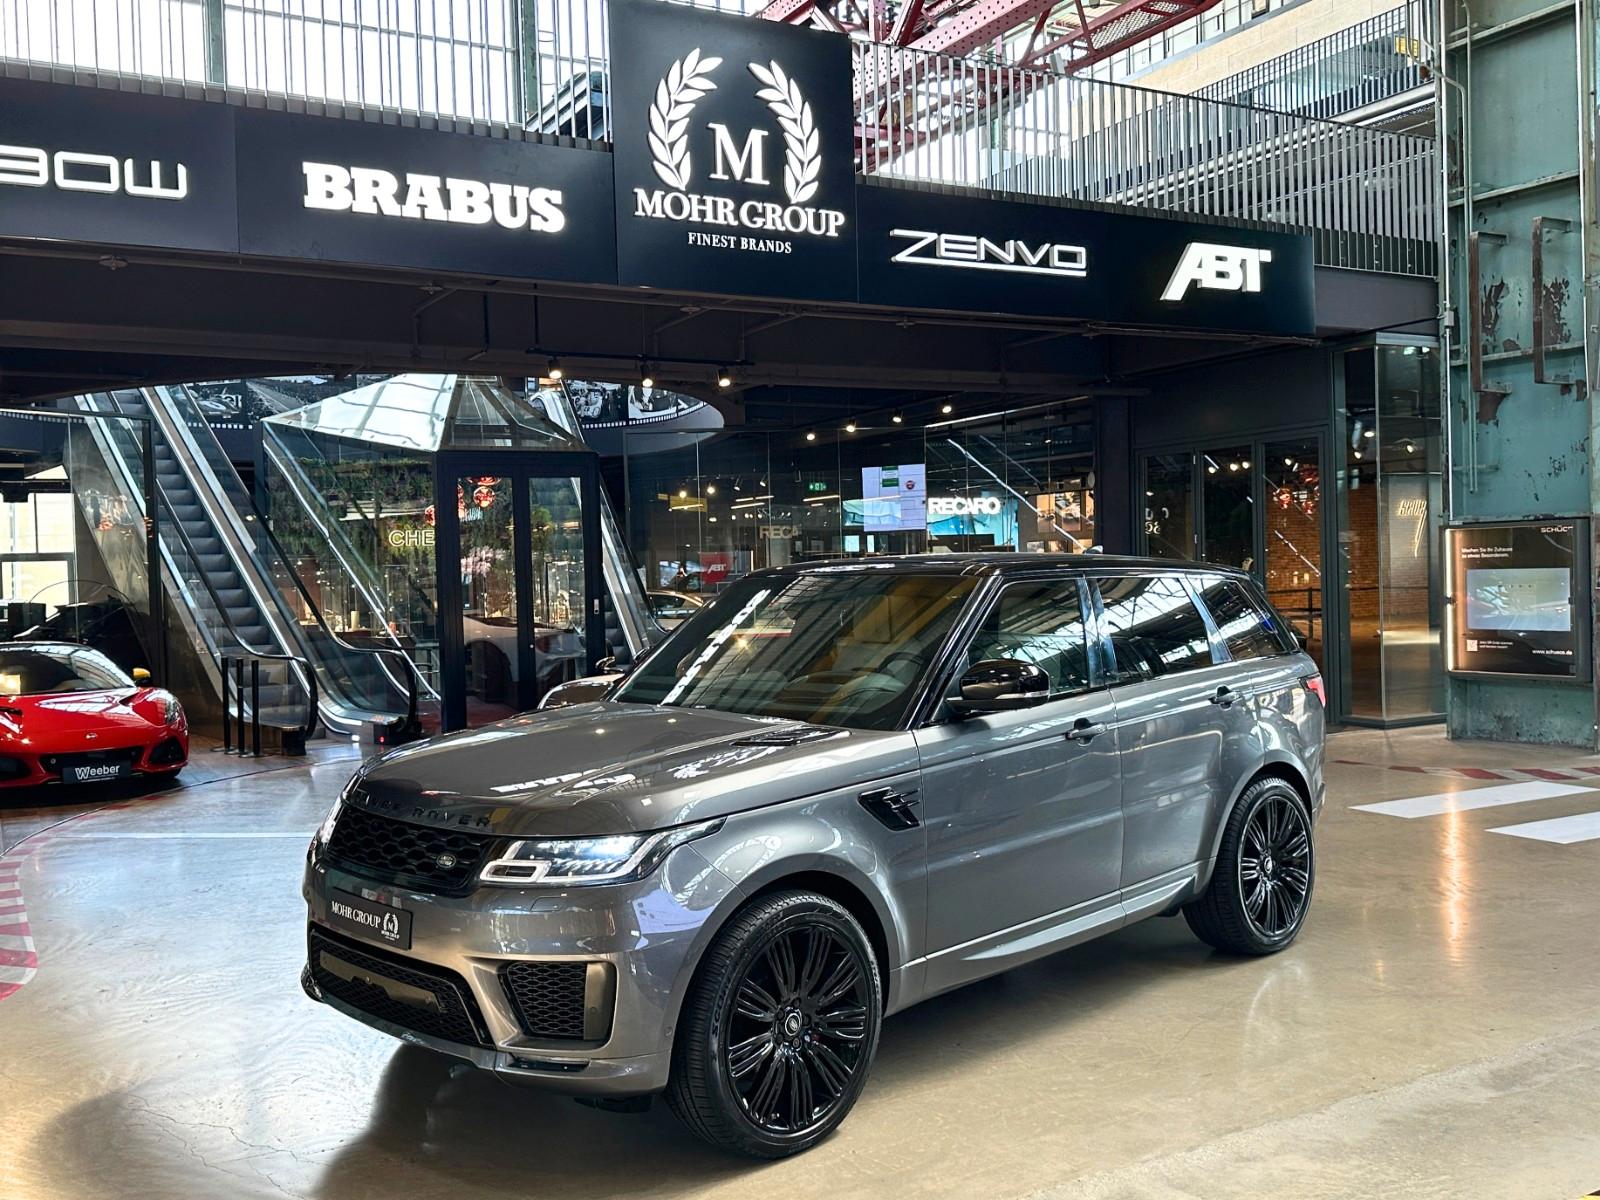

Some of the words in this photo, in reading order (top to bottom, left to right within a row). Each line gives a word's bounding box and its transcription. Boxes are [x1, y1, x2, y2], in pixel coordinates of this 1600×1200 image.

[707, 122, 771, 186] M
[302, 161, 566, 234] BRABUS
[633, 187, 738, 226] MOHR
[738, 200, 846, 238] GROUP
[687, 231, 737, 249] FINEST
[740, 236, 792, 254] BRANDS
[890, 228, 1087, 278] ZENVO
[1160, 242, 1272, 301] ABT
[927, 496, 1001, 515] RECARO
[1540, 525, 1574, 534] SCHÜC
[706, 563, 726, 574] ABT
[75, 765, 120, 780] Weeber
[331, 900, 352, 920] MOHR
[352, 909, 381, 928] GROUP
